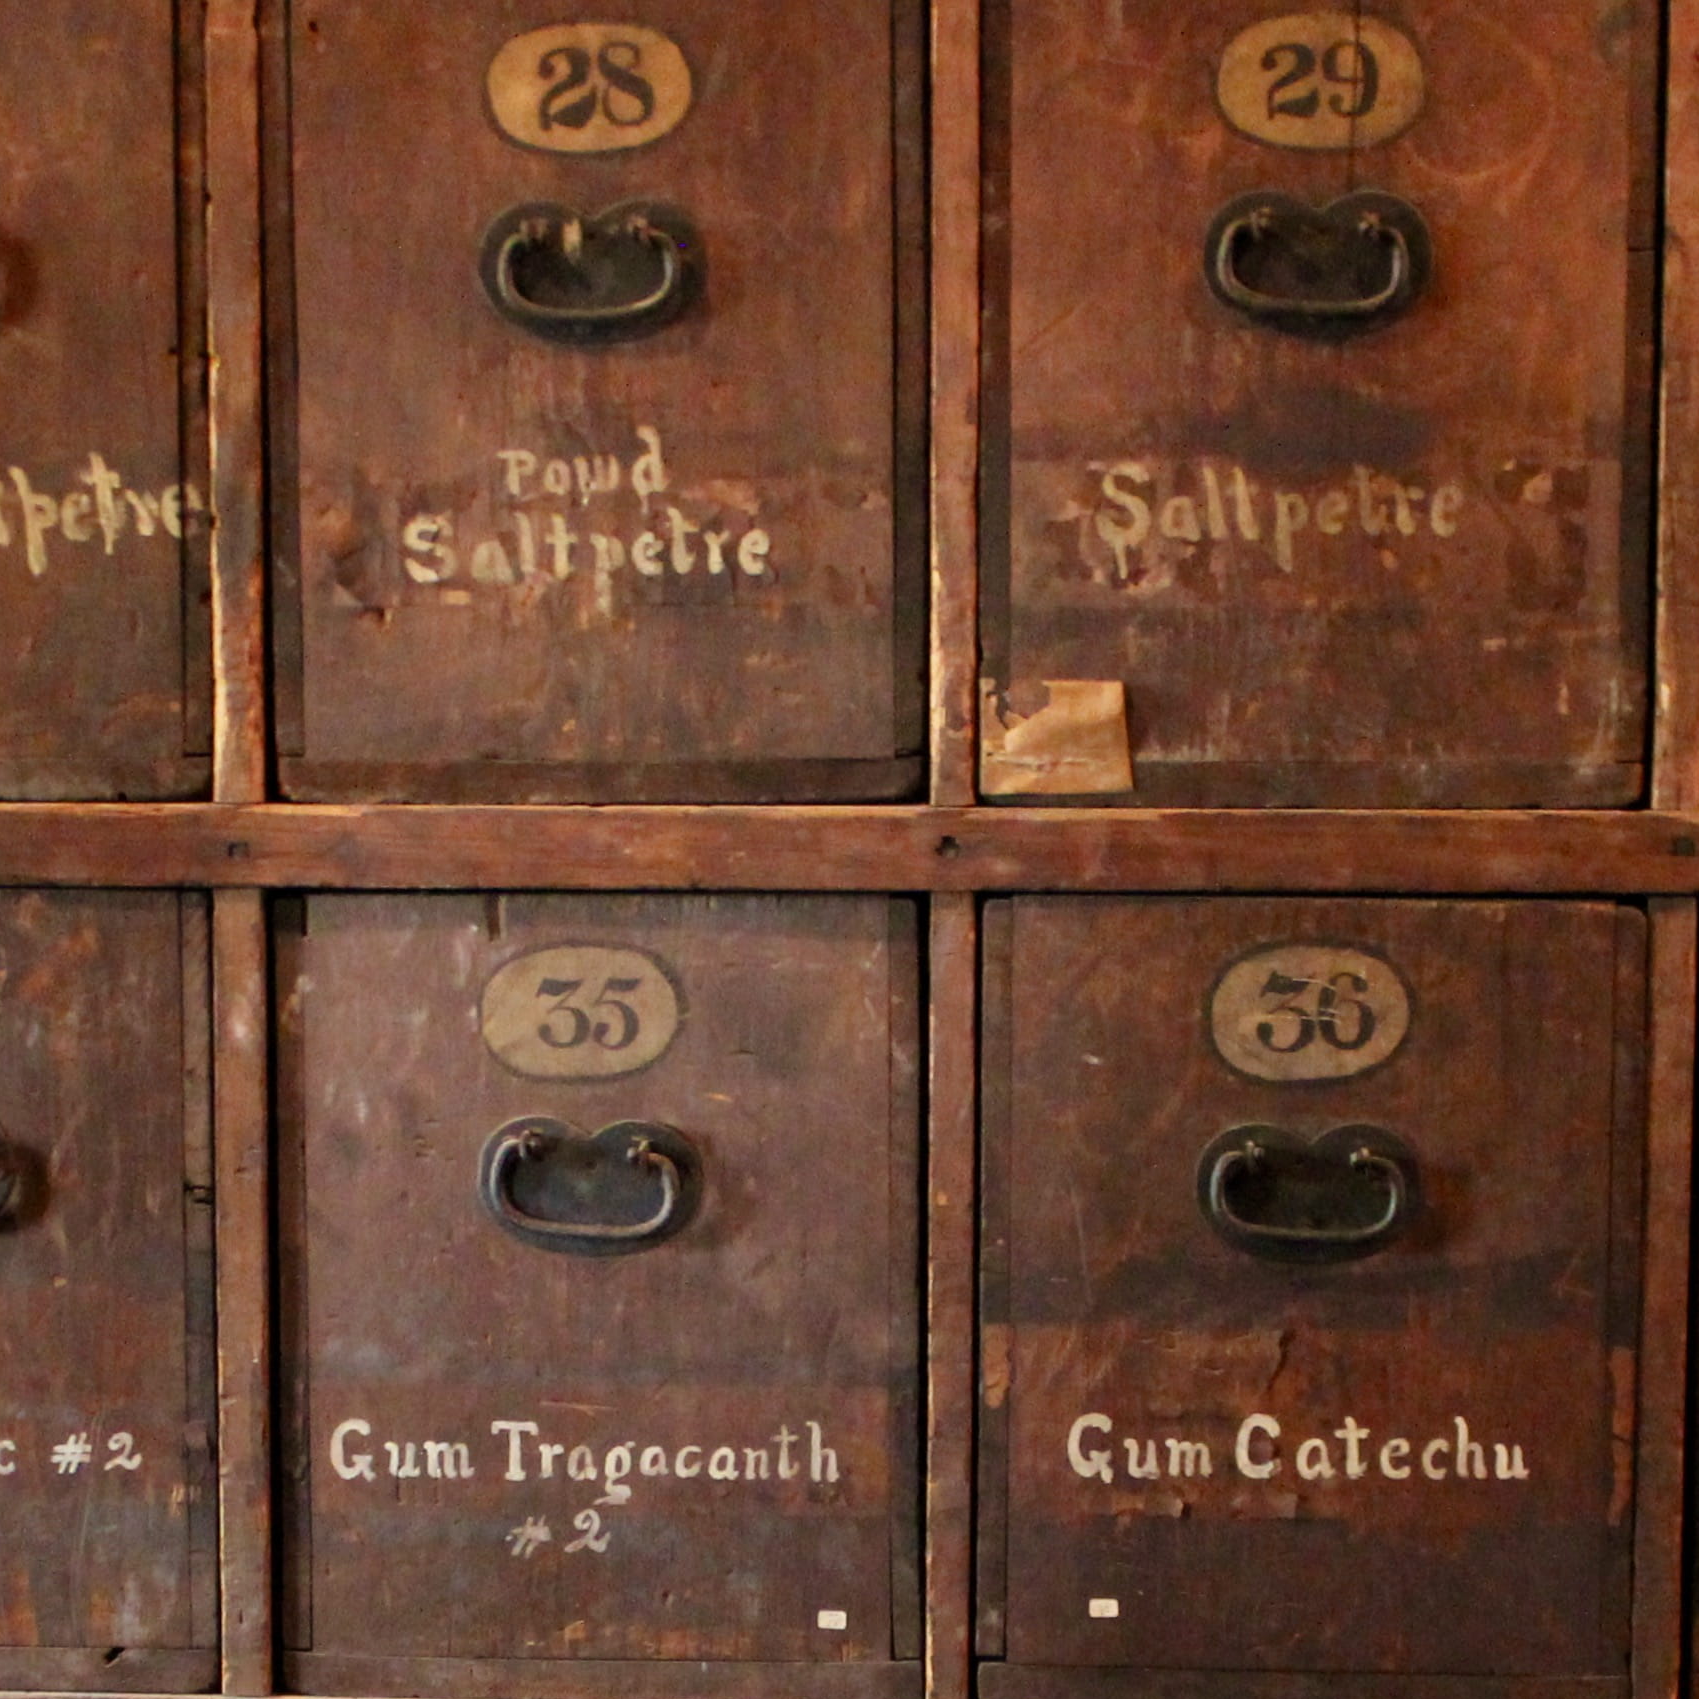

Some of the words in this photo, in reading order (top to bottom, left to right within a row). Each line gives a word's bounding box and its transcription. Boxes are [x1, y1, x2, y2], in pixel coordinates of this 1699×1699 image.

[537, 42, 654, 131] 28
[1261, 41, 1380, 121] 29
[403, 508, 771, 614] Saltpetre
[1096, 460, 1463, 578] Saltpetre
[533, 976, 641, 1050] 35
[1254, 968, 1378, 1054] 36
[329, 1418, 477, 1484] Gum
[491, 1418, 842, 1506] Tragacanth
[1067, 1412, 1213, 1485] Gum
[1234, 1412, 1530, 1484] Catechu
